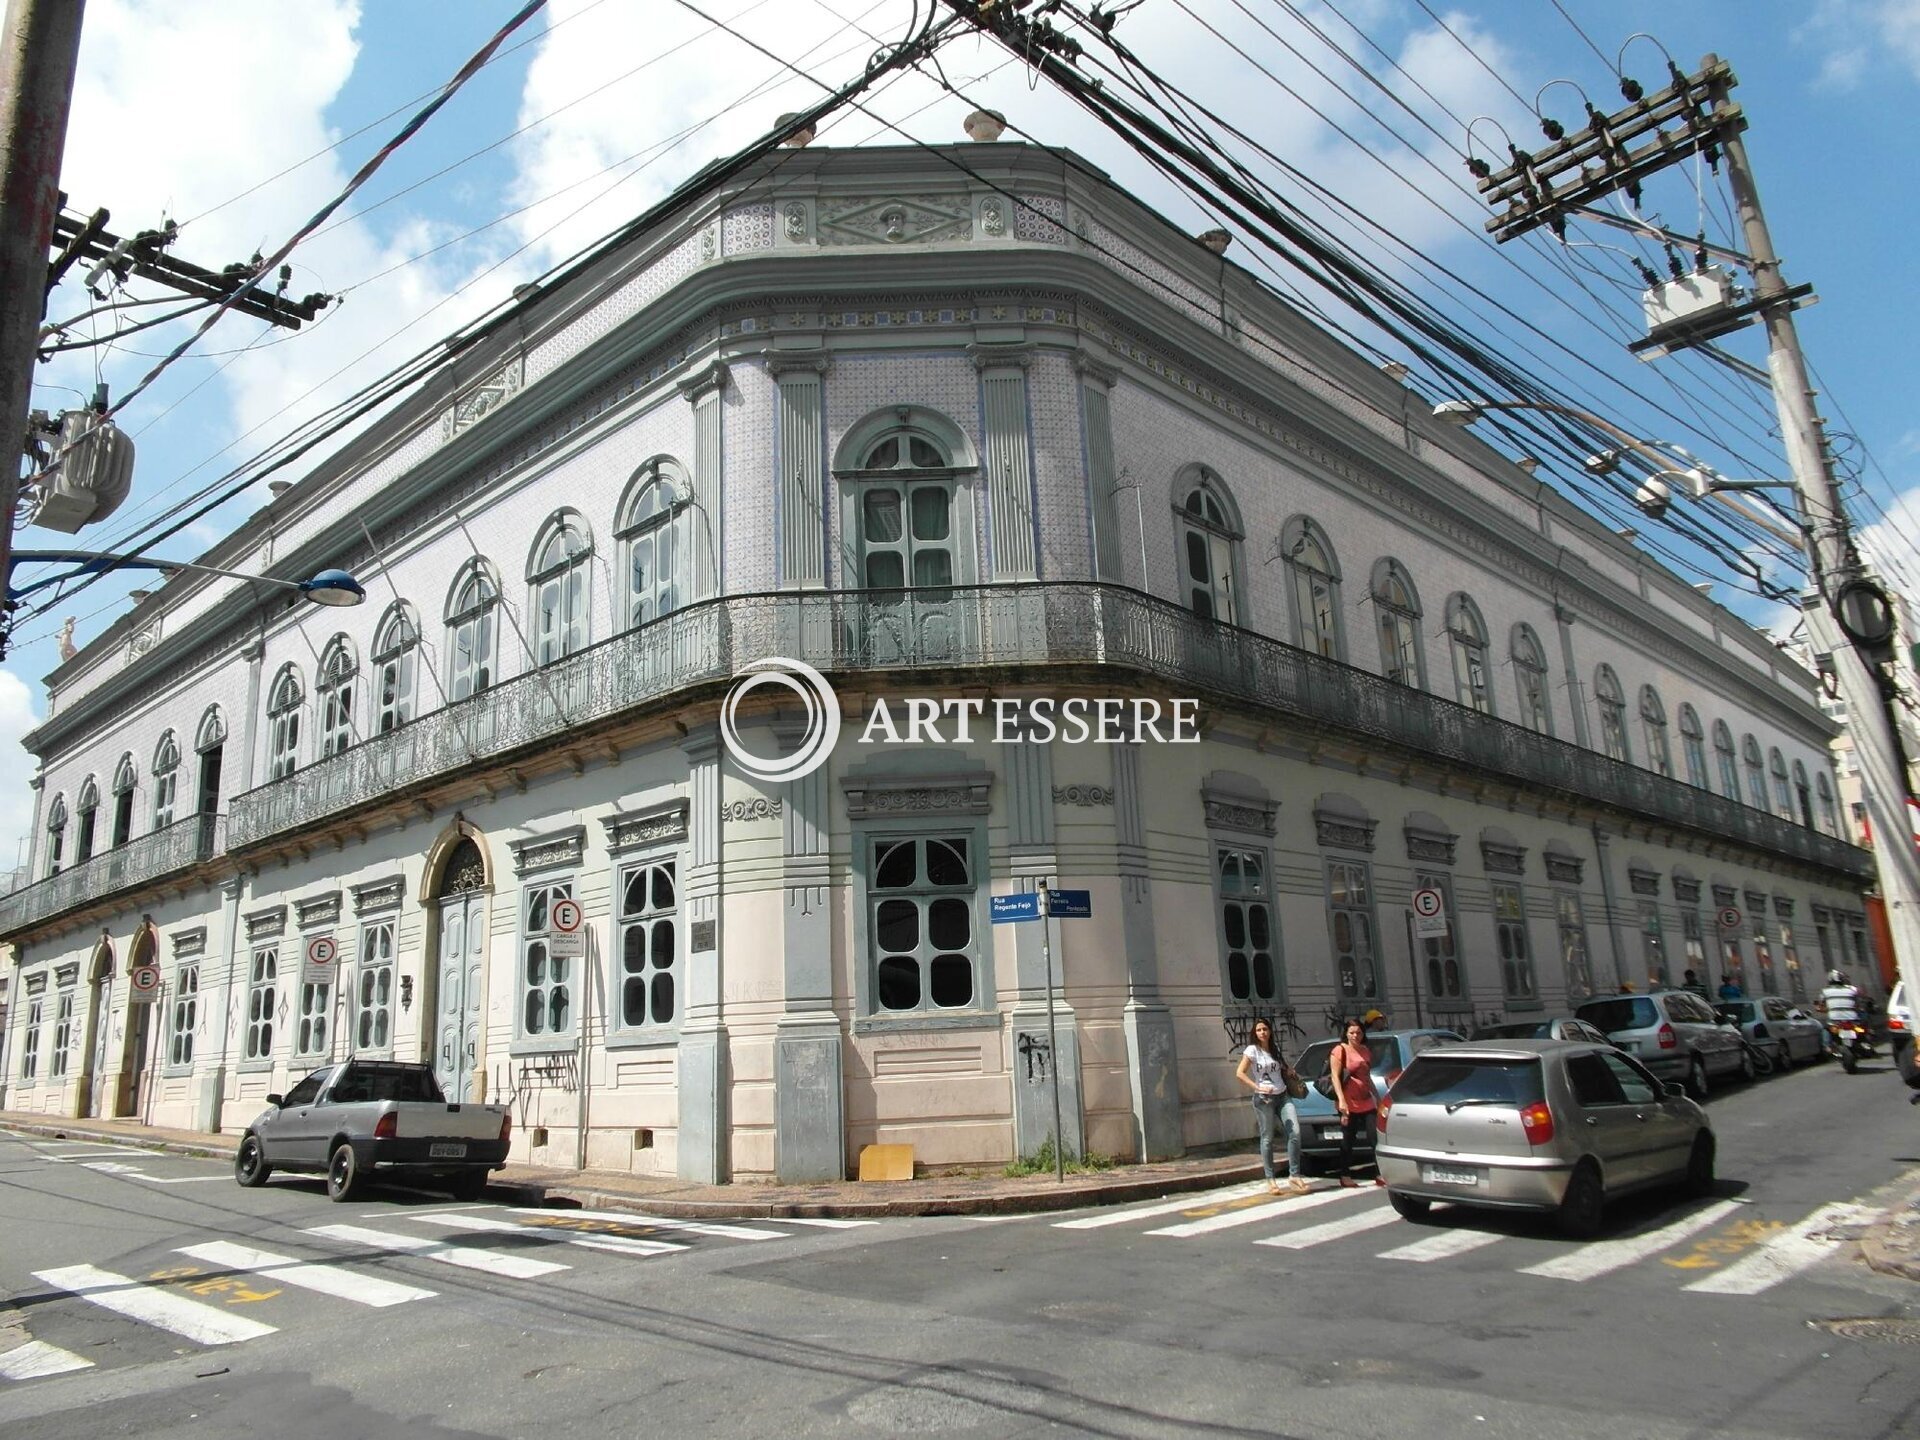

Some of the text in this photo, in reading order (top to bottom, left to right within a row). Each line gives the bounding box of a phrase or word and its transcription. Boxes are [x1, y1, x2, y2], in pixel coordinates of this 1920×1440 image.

[1423, 896, 1432, 910] E
[562, 908, 571, 924] E
[1725, 912, 1735, 923] E
[317, 944, 327, 958] E
[141, 972, 151, 985] E
